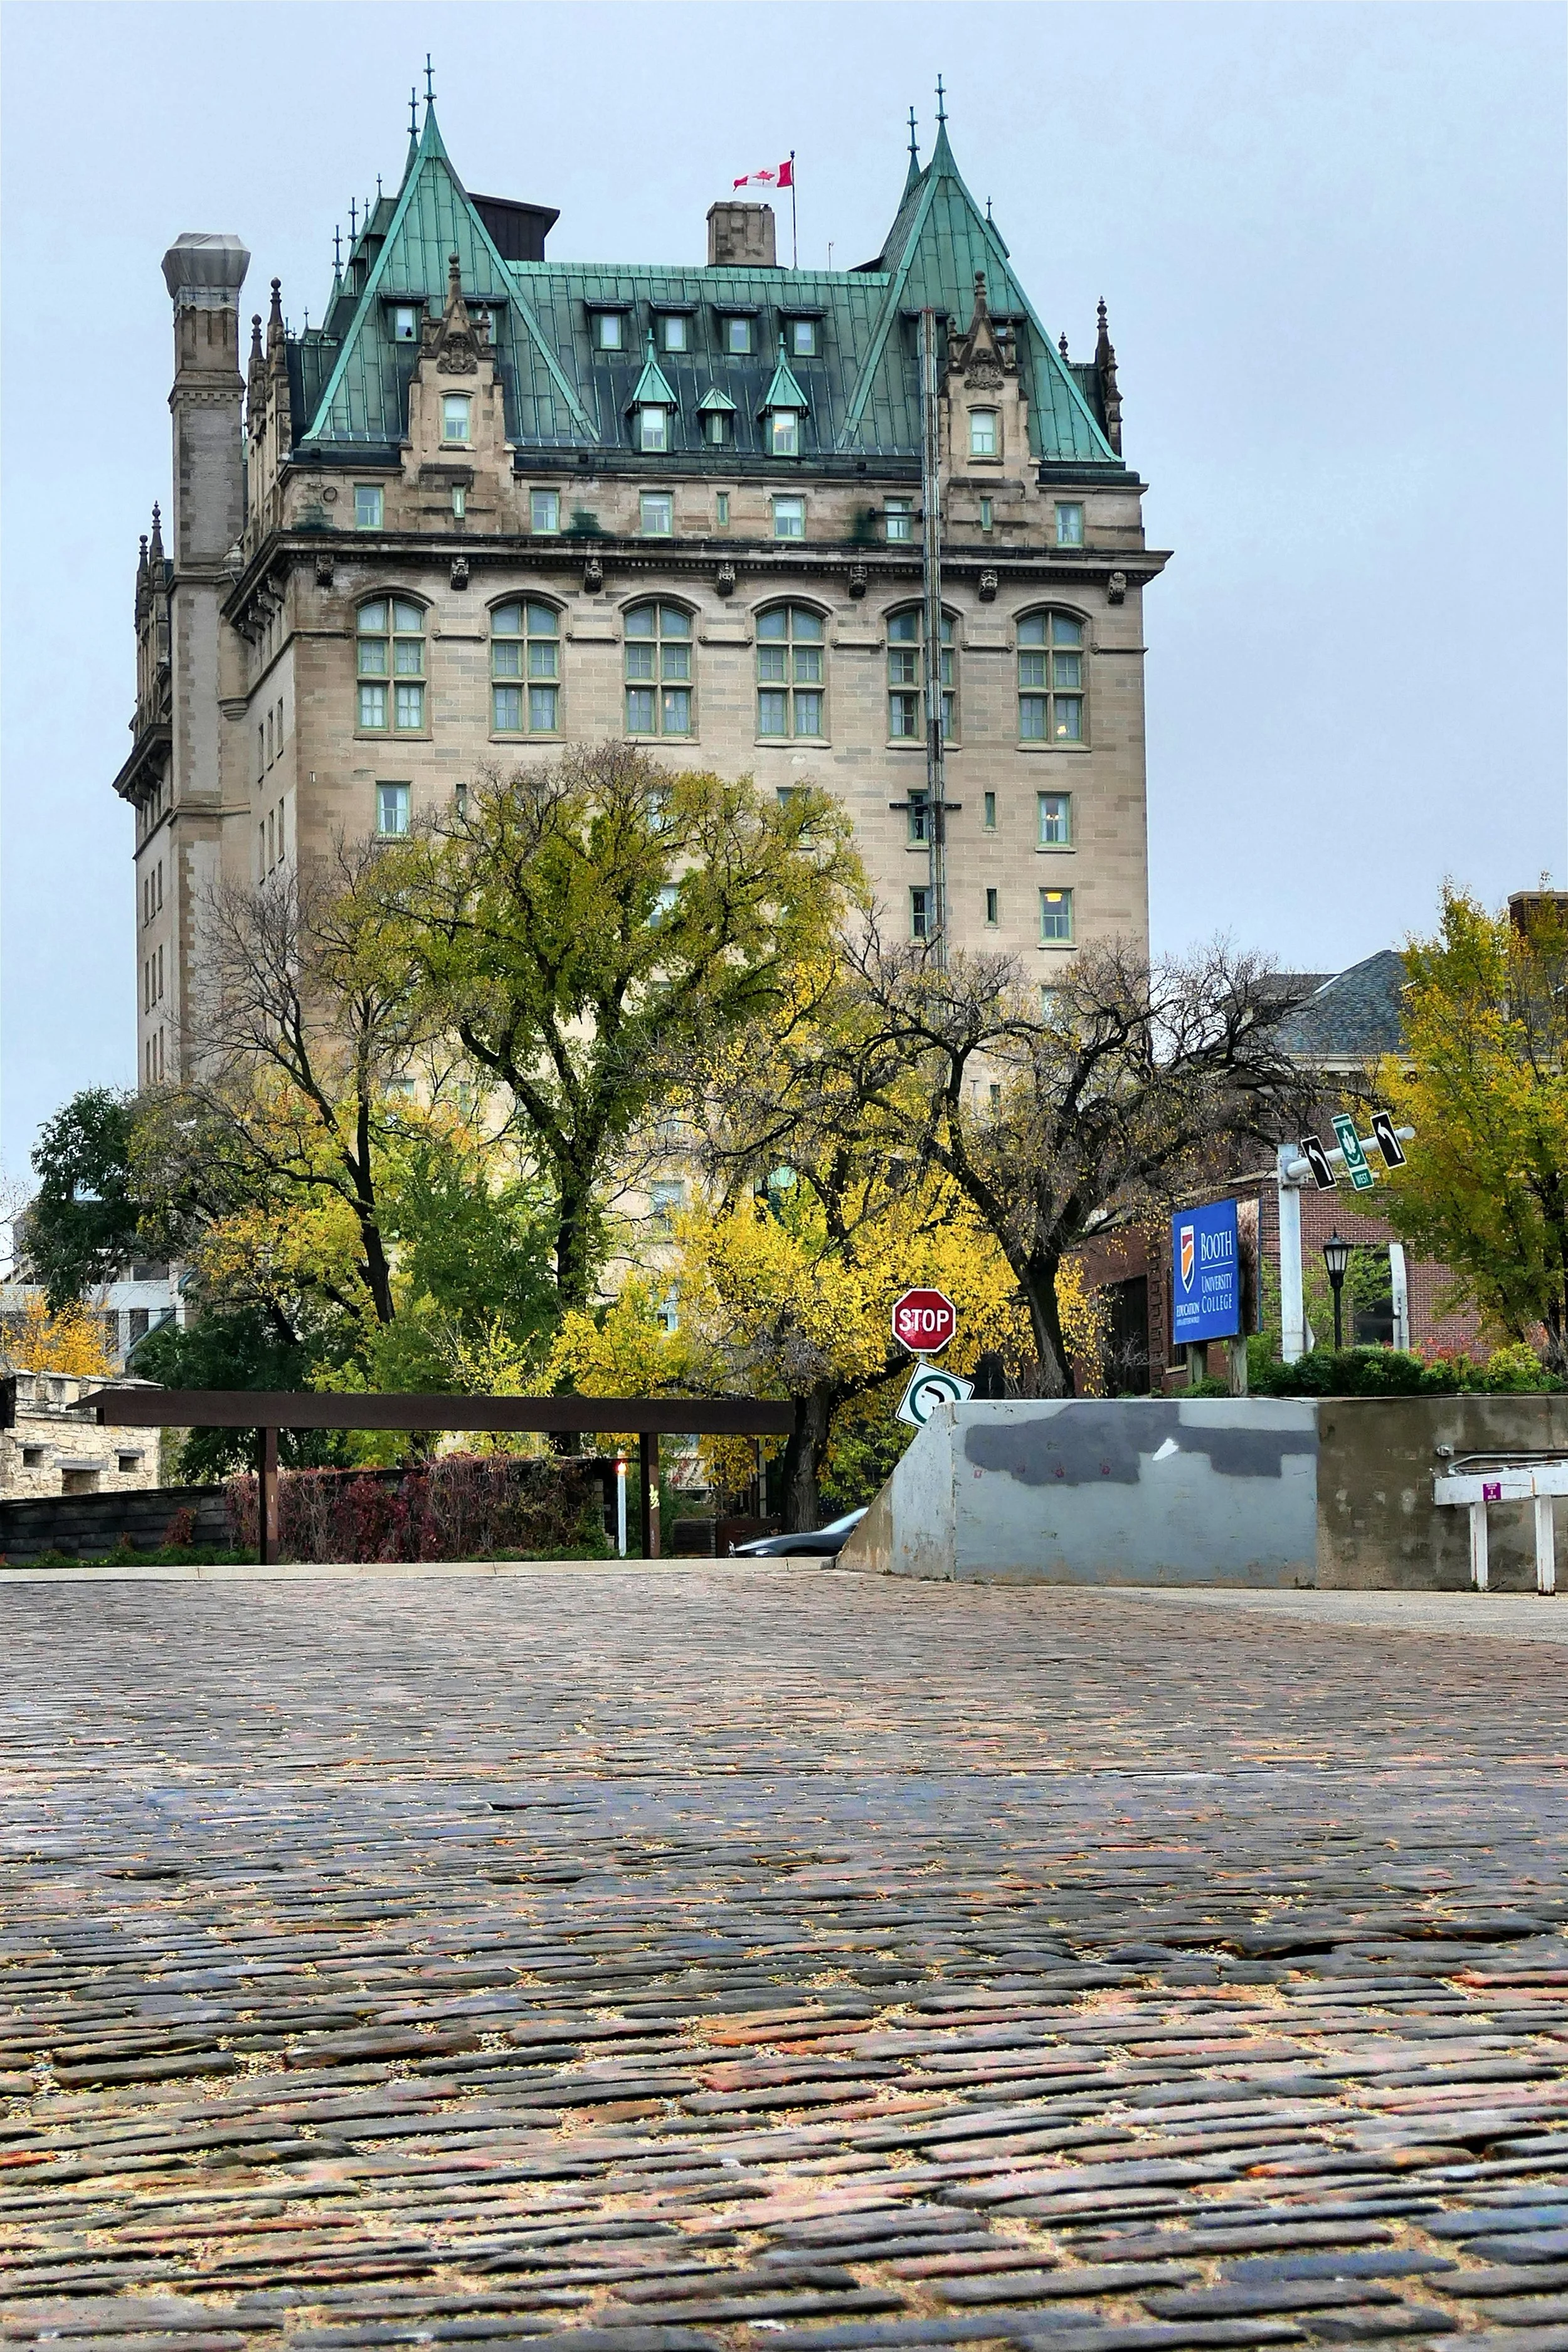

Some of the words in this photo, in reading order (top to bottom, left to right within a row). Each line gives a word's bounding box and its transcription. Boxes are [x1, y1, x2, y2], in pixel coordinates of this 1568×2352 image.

[1355, 1173, 1369, 1185] WEST
[1200, 1231, 1232, 1261] BOOTH
[1201, 1273, 1233, 1293] UNIVERSITY
[1176, 1301, 1200, 1317] EDUCATION
[1201, 1293, 1232, 1313] COLLEGE
[899, 1308, 950, 1332] STOP
